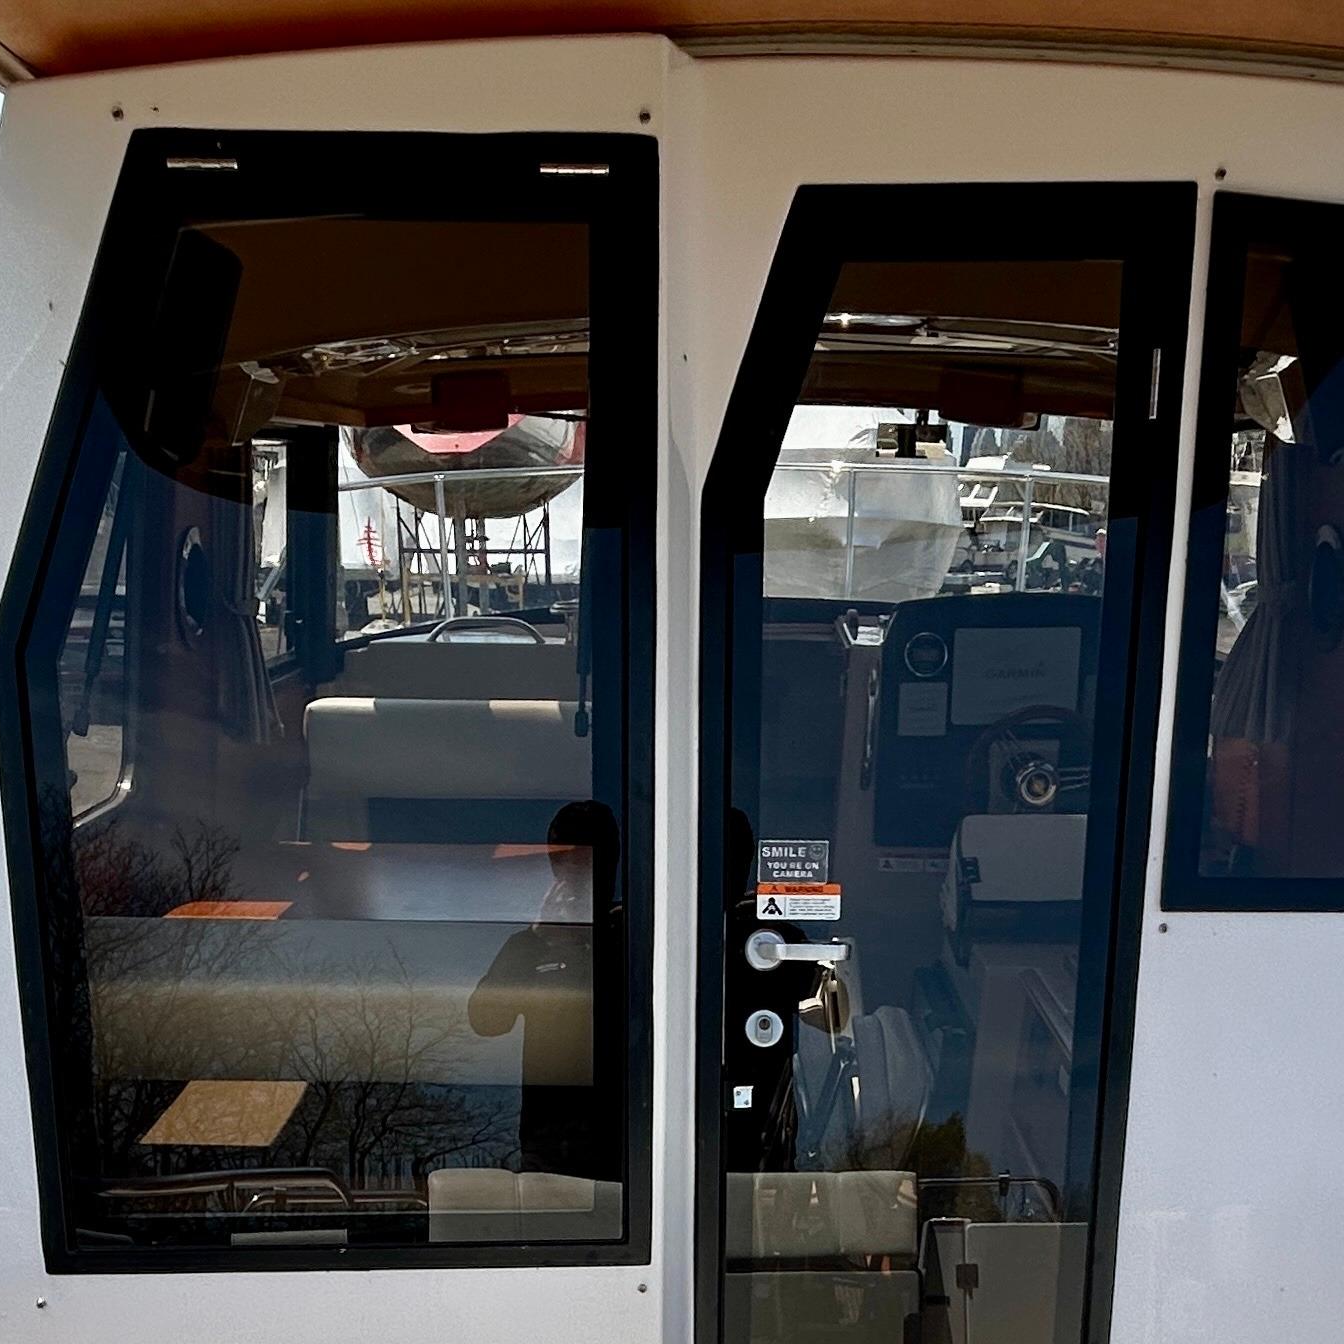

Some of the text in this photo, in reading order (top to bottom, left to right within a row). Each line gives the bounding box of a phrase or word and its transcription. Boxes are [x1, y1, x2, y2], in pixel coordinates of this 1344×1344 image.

[761, 846, 807, 858] SMILE
[805, 861, 819, 870] ON
[772, 870, 813, 878] CAMERA
